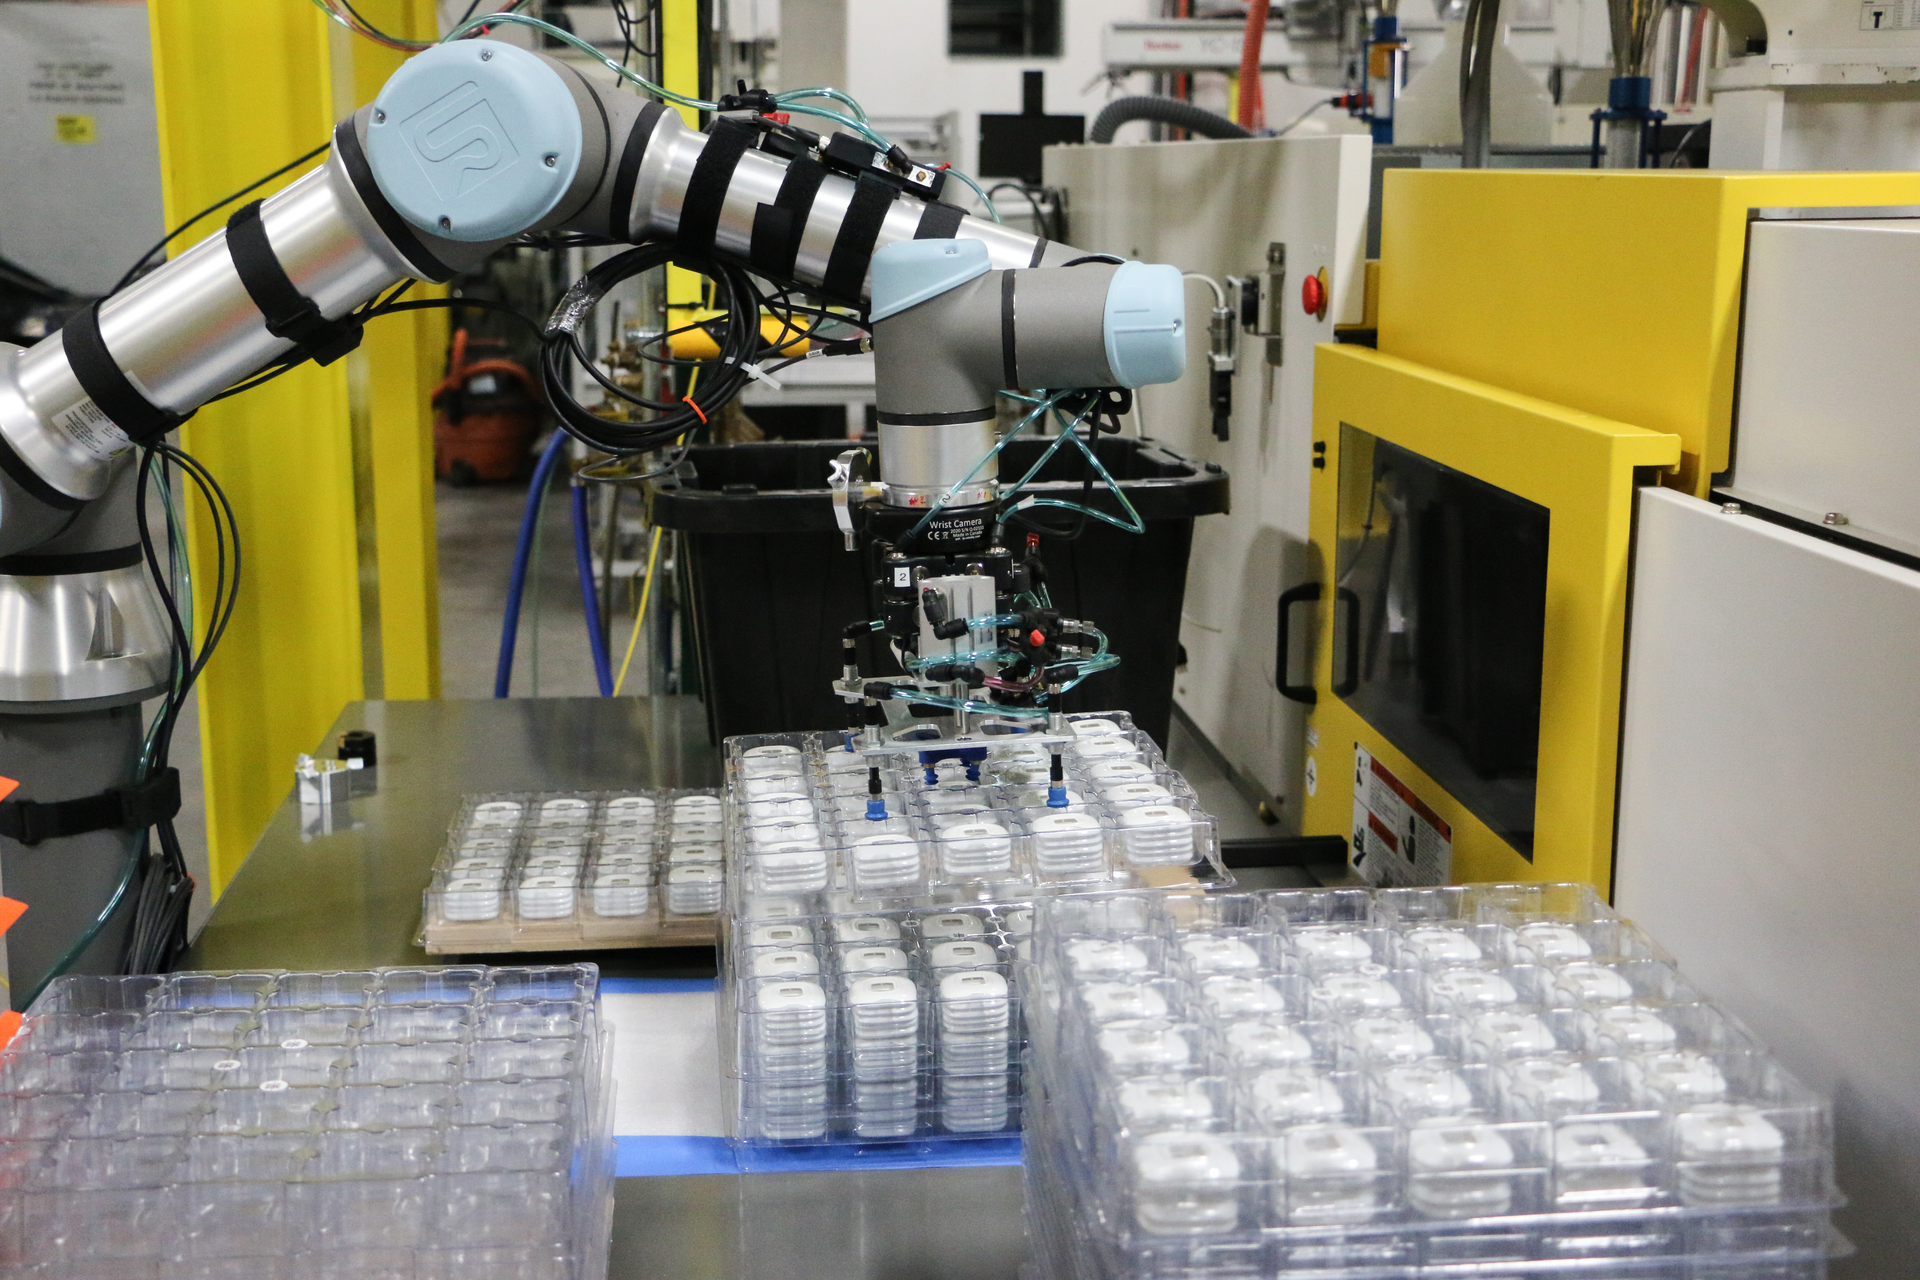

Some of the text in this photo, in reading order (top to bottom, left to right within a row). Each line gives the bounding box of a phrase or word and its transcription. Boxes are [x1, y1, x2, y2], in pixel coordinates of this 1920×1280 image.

[942, 493, 951, 504] 2
[929, 518, 982, 529] Wrist Camera
[899, 572, 907, 582] 2
